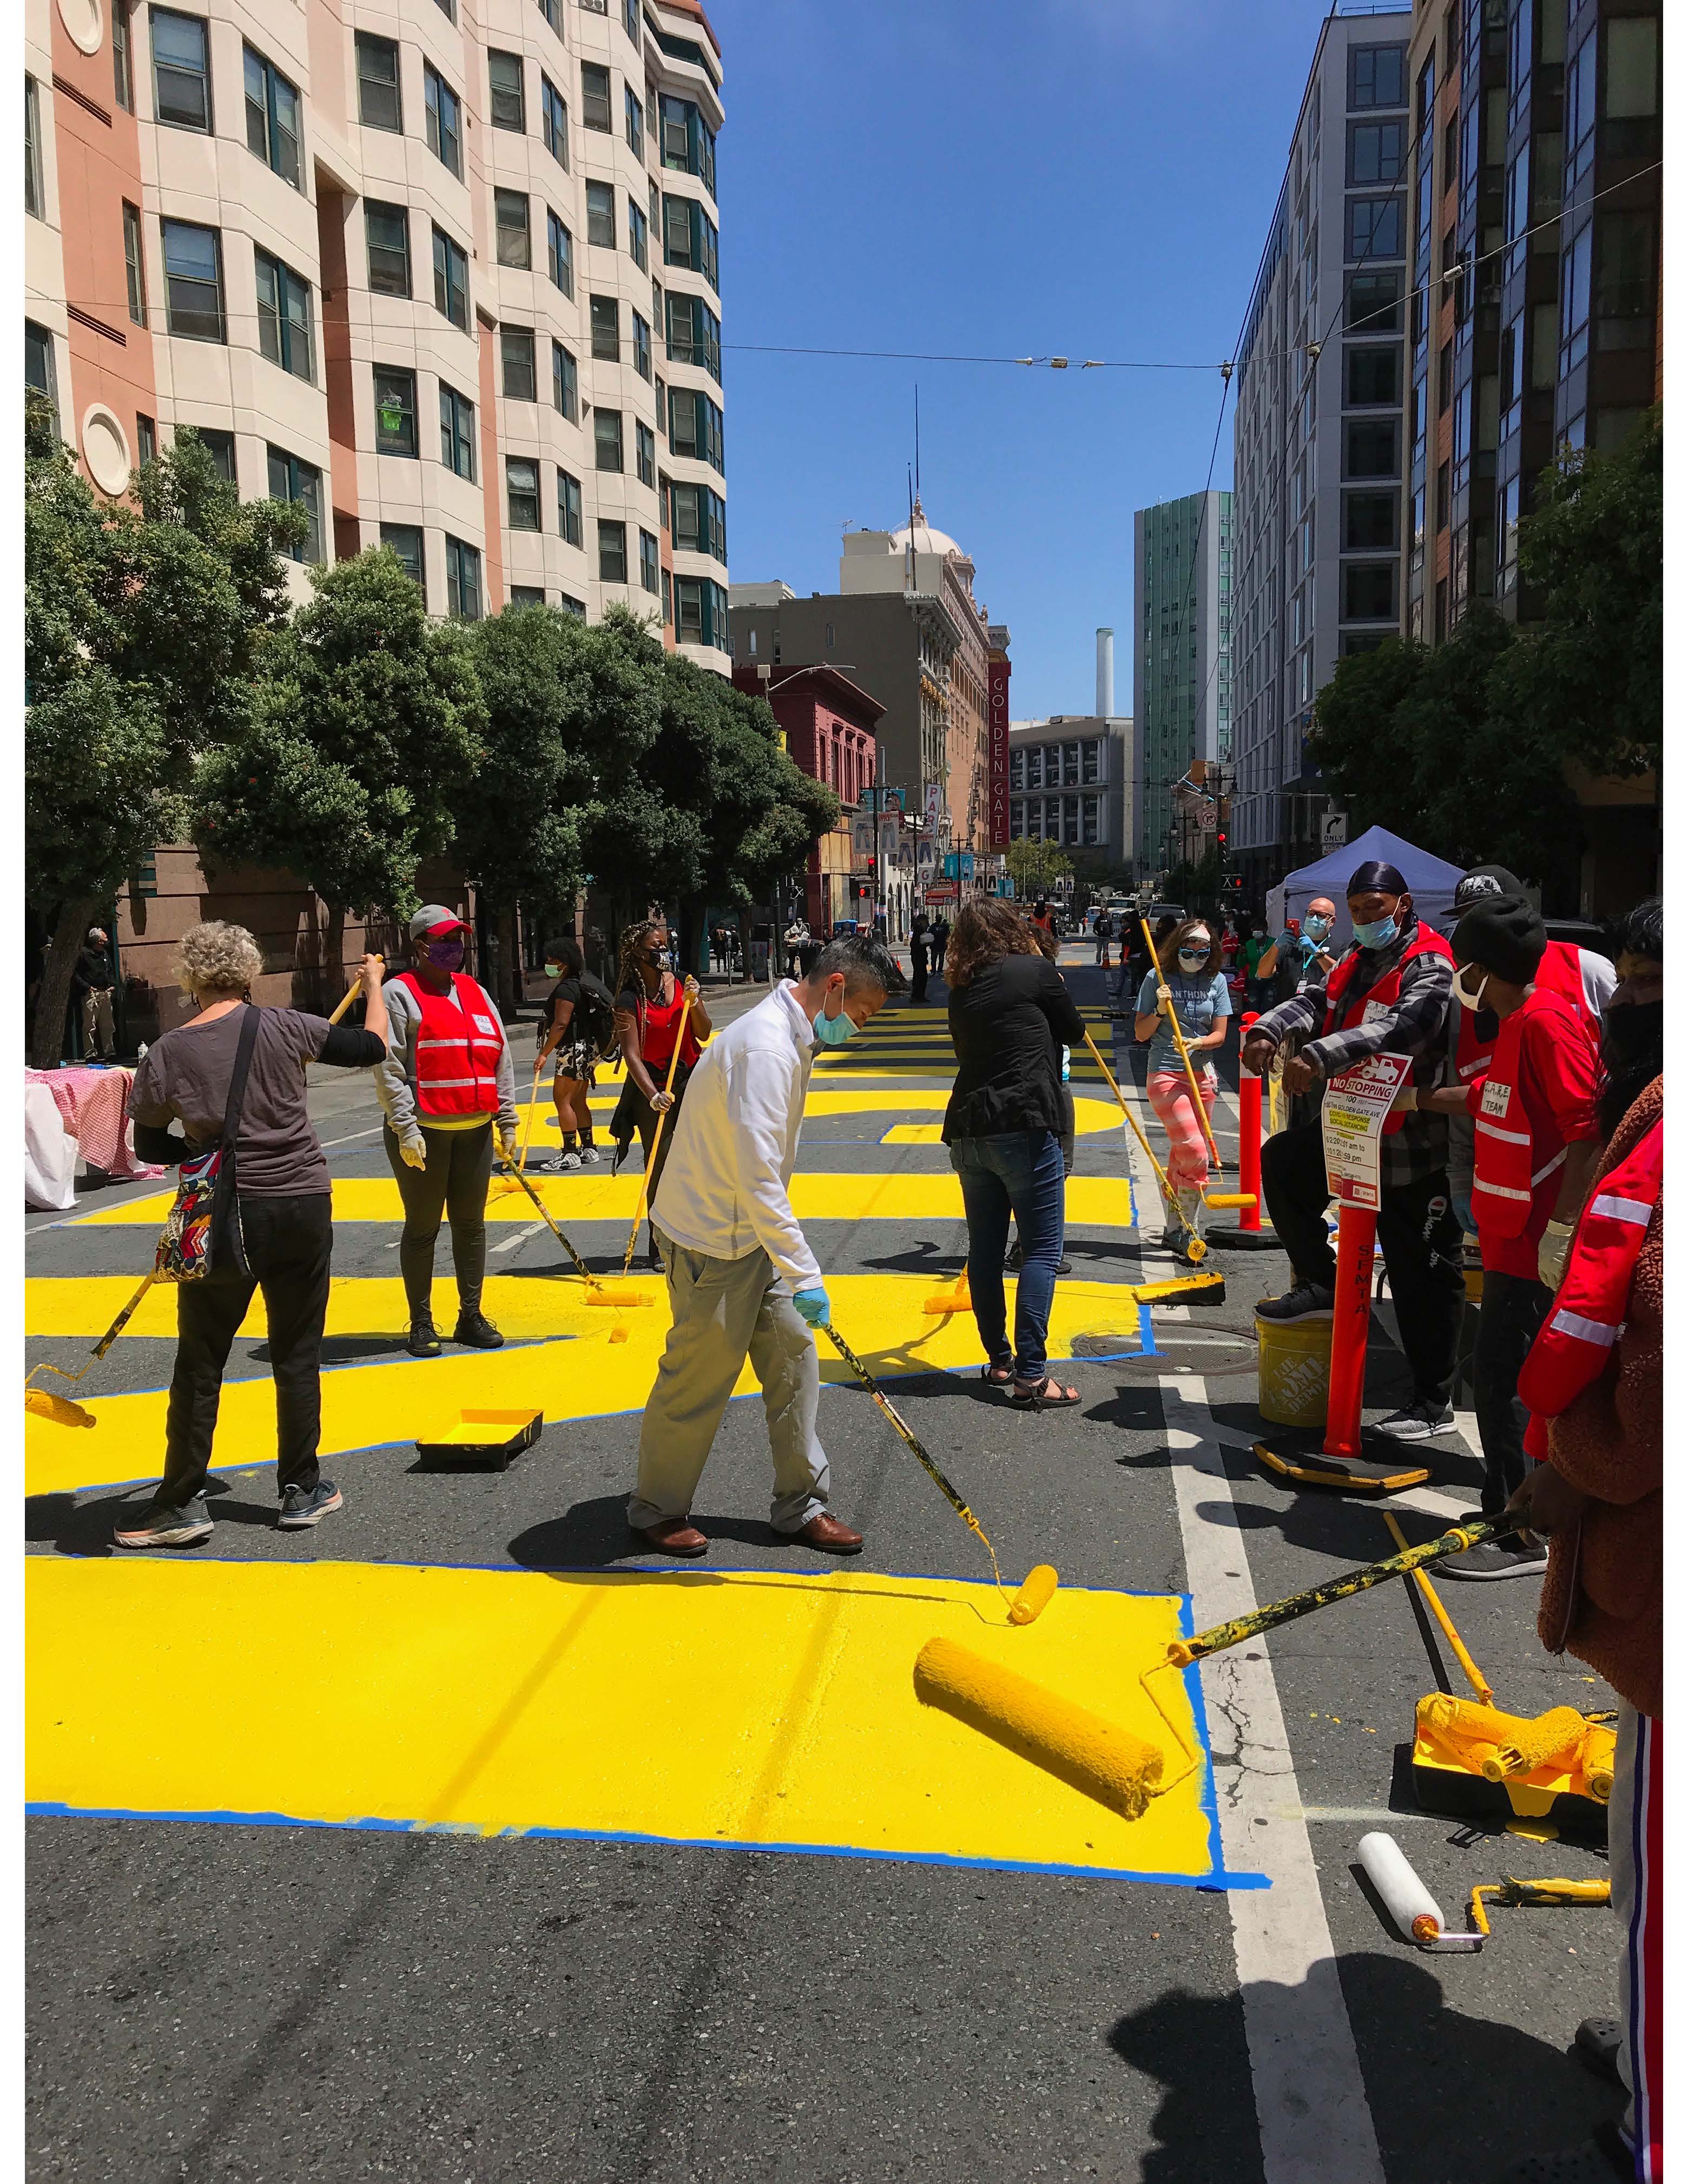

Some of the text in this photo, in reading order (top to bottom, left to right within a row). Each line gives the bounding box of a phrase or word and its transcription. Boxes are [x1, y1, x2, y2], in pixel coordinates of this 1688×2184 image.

[992, 677, 1005, 843] GOLDEN GATE
[1333, 1077, 1393, 1098] NO STOPPING
[1346, 1095, 1357, 1104] 100
[1337, 1104, 1356, 1113] GOLDEN
[1356, 1108, 1370, 1116] GATE
[1486, 1100, 1504, 1116] TEAM
[1359, 1144, 1365, 1152] to
[1352, 1154, 1362, 1163] pm
[1422, 1196, 1448, 1268] Chamon
[1355, 1245, 1370, 1314] SFMTA
